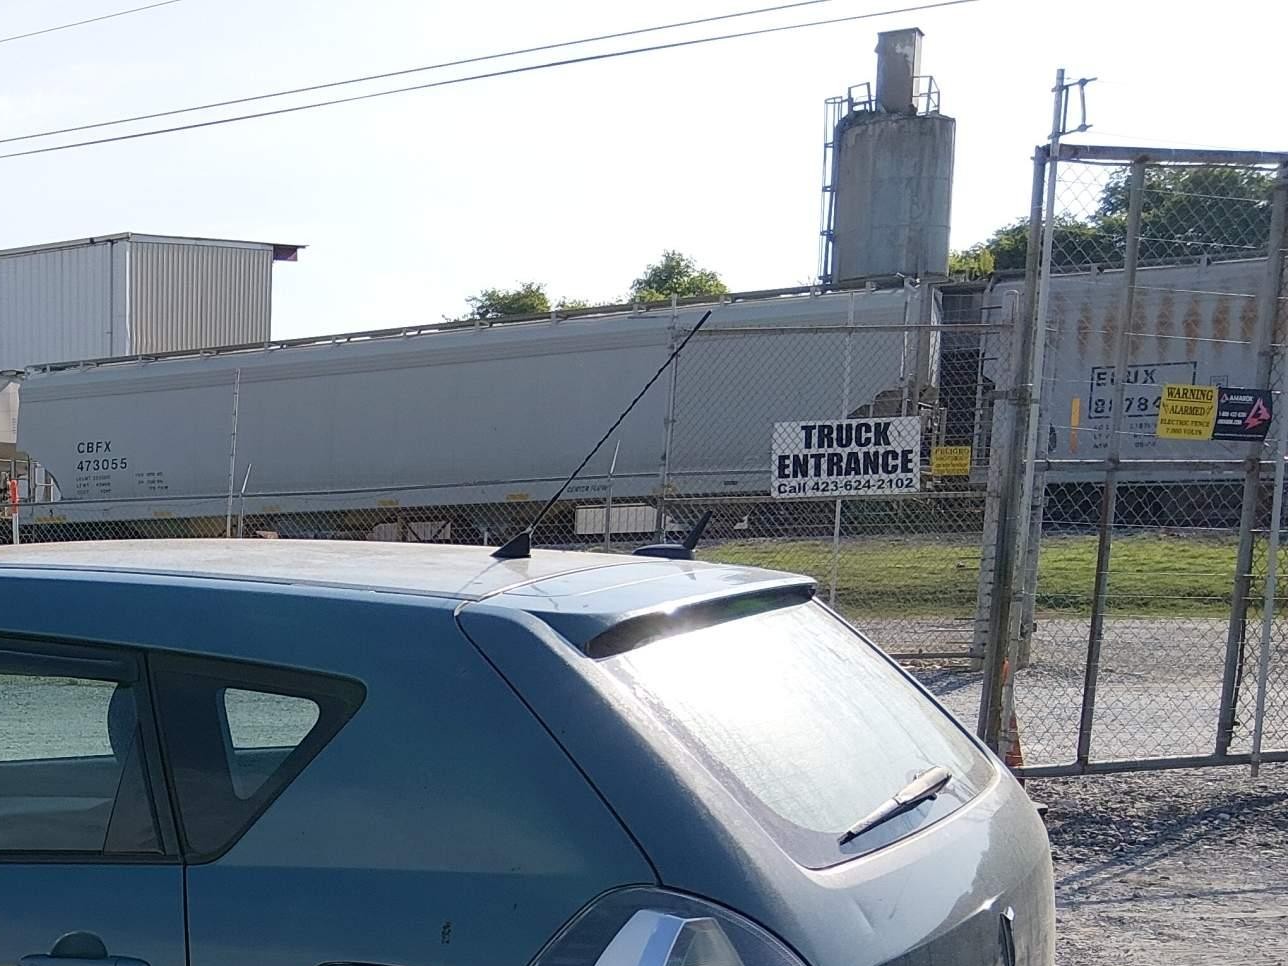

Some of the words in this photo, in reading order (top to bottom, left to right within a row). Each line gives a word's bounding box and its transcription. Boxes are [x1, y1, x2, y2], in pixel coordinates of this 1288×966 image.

[1167, 387, 1214, 401] WARNING
[1169, 405, 1205, 416] ALARMED
[801, 422, 892, 449] TRUCK
[77, 441, 111, 453] CBFX
[77, 458, 127, 471] 473055
[777, 449, 914, 479] ENTRANCE
[777, 483, 806, 494] Call
[812, 477, 914, 492] 423-624-2102
